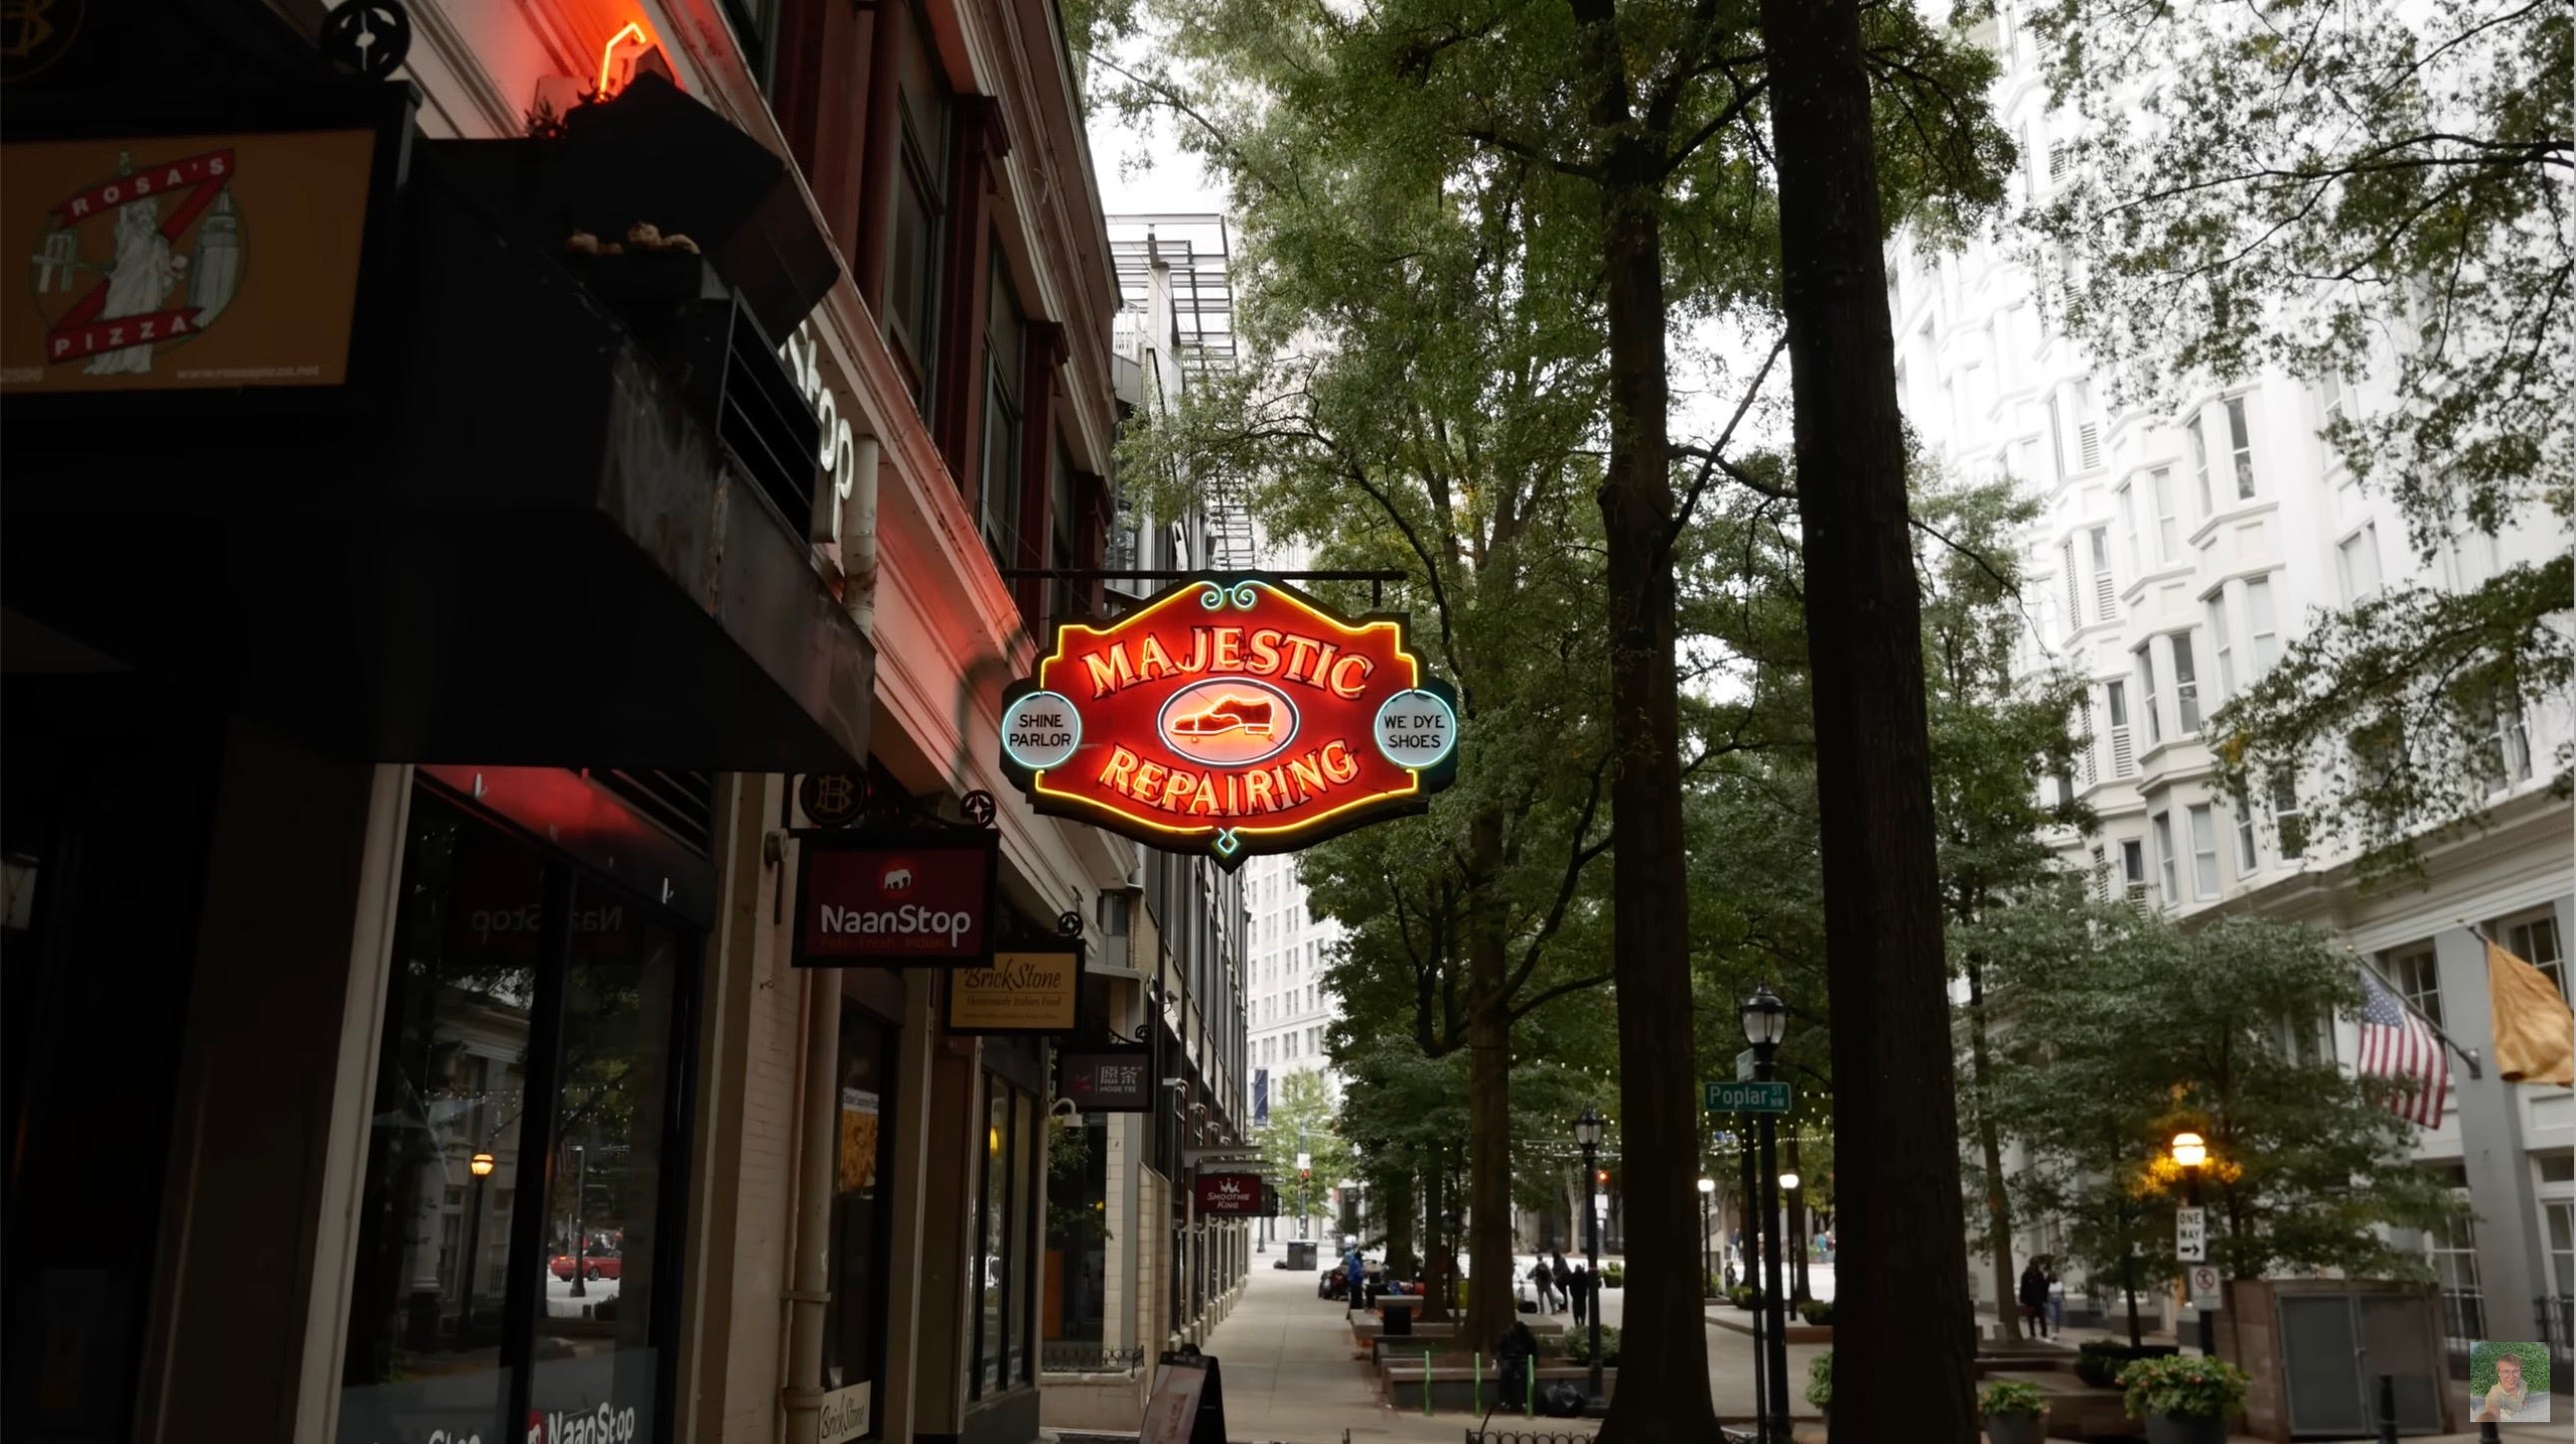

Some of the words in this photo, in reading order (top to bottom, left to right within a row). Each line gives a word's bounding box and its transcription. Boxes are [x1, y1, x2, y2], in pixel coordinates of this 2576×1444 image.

[72, 157, 225, 217] ROSA'S
[55, 316, 188, 357] PIZZA
[1080, 626, 1376, 700] MAJESTIC
[1019, 713, 1063, 729] SHINE
[1384, 715, 1409, 729] WE
[1413, 714, 1446, 729] DYE
[1009, 733, 1072, 748] PARLOR
[1389, 733, 1442, 749] SHOES
[1098, 738, 1359, 818] REPAIRING
[820, 903, 971, 949] NaanStop
[965, 958, 1061, 991] BrickStone
[1709, 1085, 1767, 1108] Poplar
[1206, 1191, 1250, 1201] SMOOTHIE
[1216, 1200, 1239, 1209] KING
[2180, 1212, 2202, 1224] ONE
[2180, 1230, 2201, 1239] WAY
[546, 1401, 635, 1444] NaanStop
